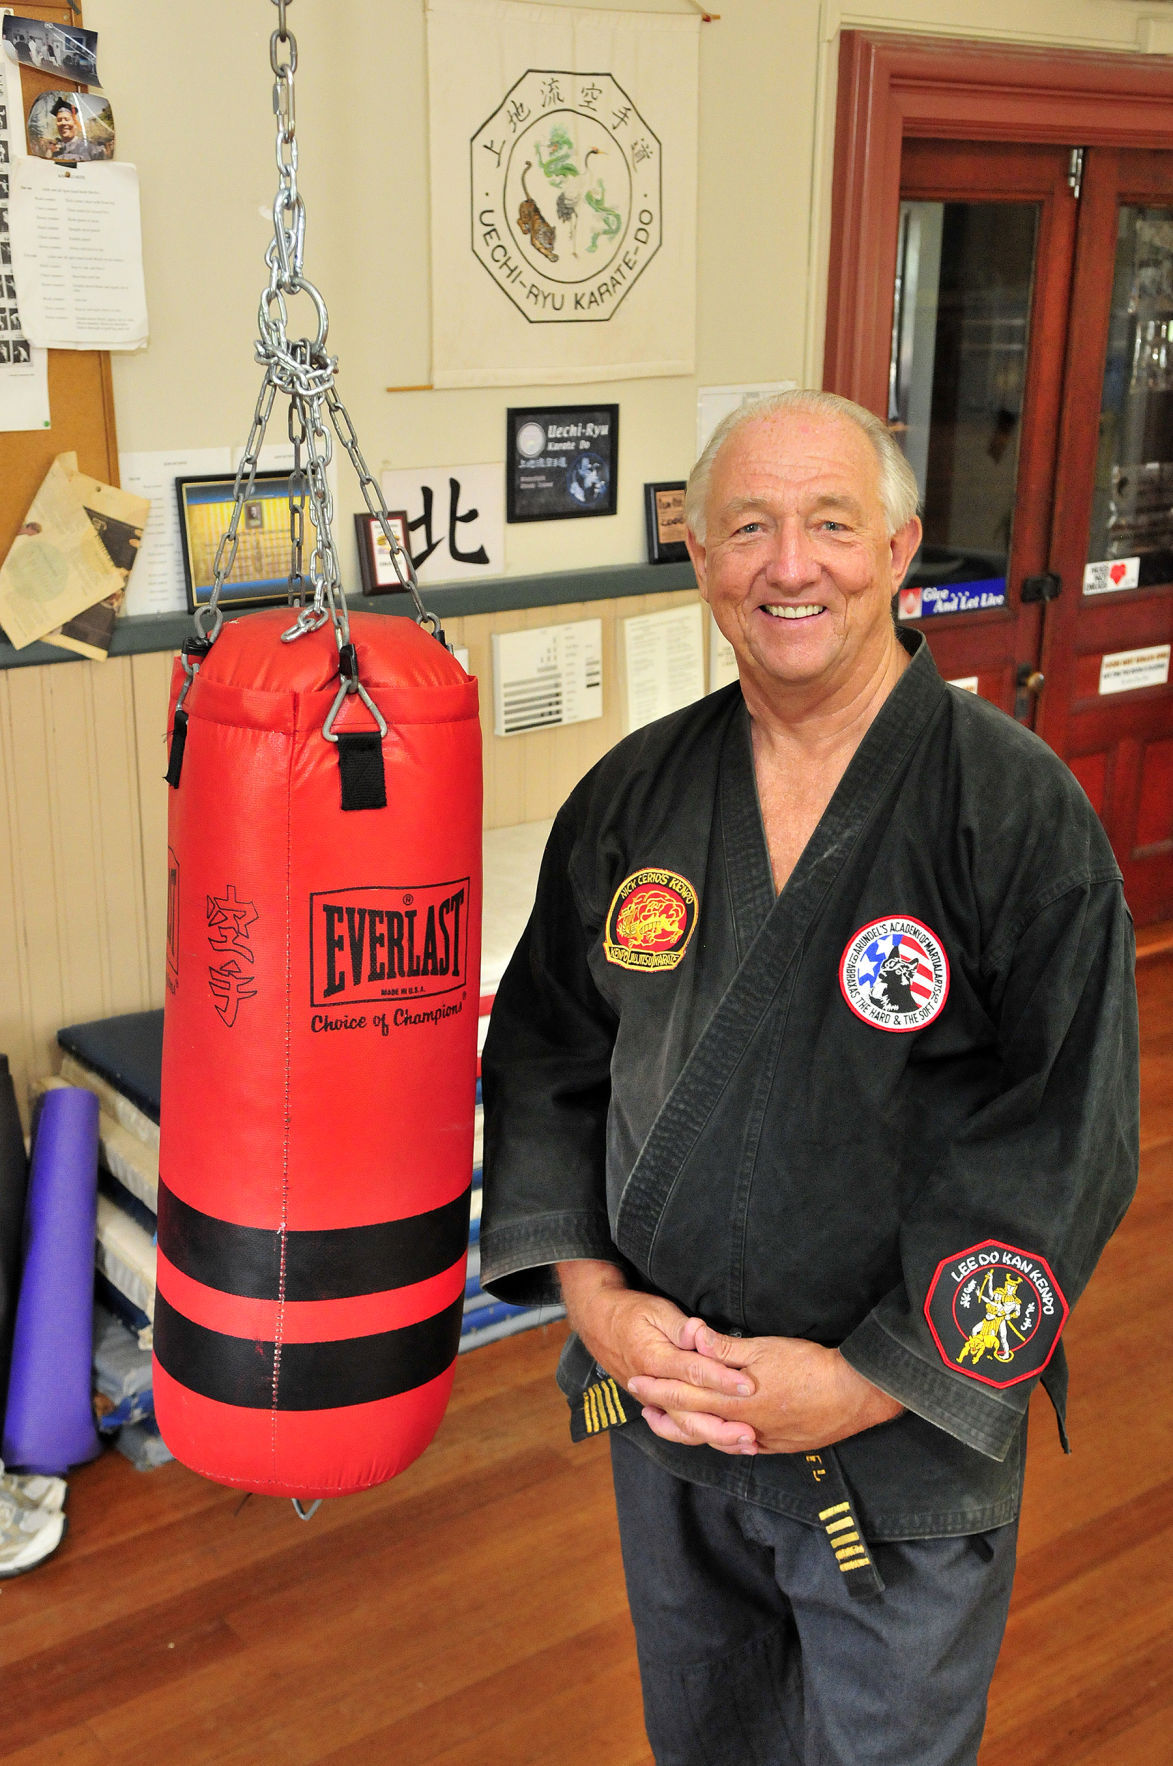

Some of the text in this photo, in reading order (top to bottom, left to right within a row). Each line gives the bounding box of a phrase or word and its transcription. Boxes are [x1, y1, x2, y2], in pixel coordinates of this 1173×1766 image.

[479, 209, 654, 311] UECHI-RYU KARATE-DO
[620, 879, 637, 899] NICK
[668, 878, 694, 904] KENPO
[323, 888, 465, 998] EVERLAST
[855, 922, 944, 994] ARUNDEL'S ACADEMY OF MARTIAL ARTS
[311, 1002, 462, 1036] Choice of Champions
[846, 963, 935, 1026] ABRAXAS THE HARD & THE SOFT
[951, 1251, 1055, 1315] LEE DO KAN KENPO
